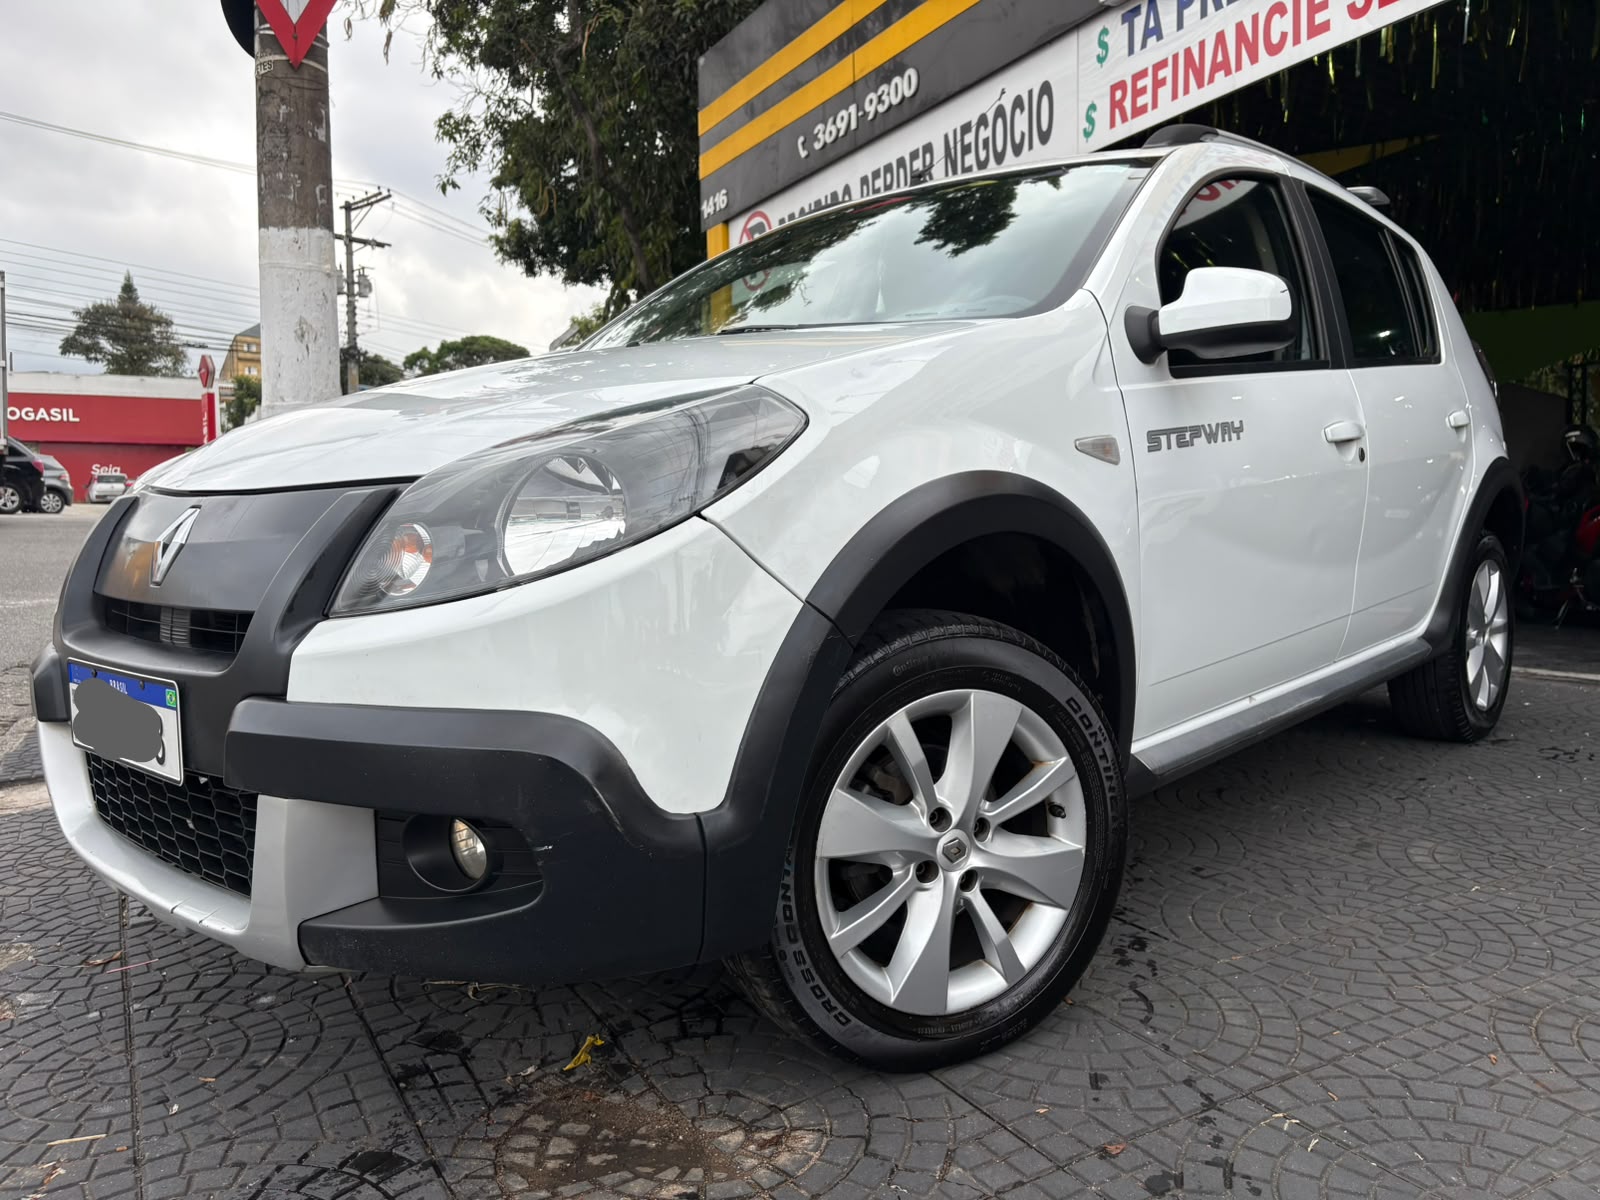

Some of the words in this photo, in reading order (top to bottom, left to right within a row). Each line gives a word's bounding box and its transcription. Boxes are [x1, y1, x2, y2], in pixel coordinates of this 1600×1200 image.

[1121, 0, 1164, 57] TA
[1109, 0, 1331, 130] REFINANCIE
[812, 67, 920, 151] 3691-9300
[701, 188, 728, 219] 1416
[7, 406, 80, 422] OGASIL
[1146, 419, 1244, 453] STEPWAY
